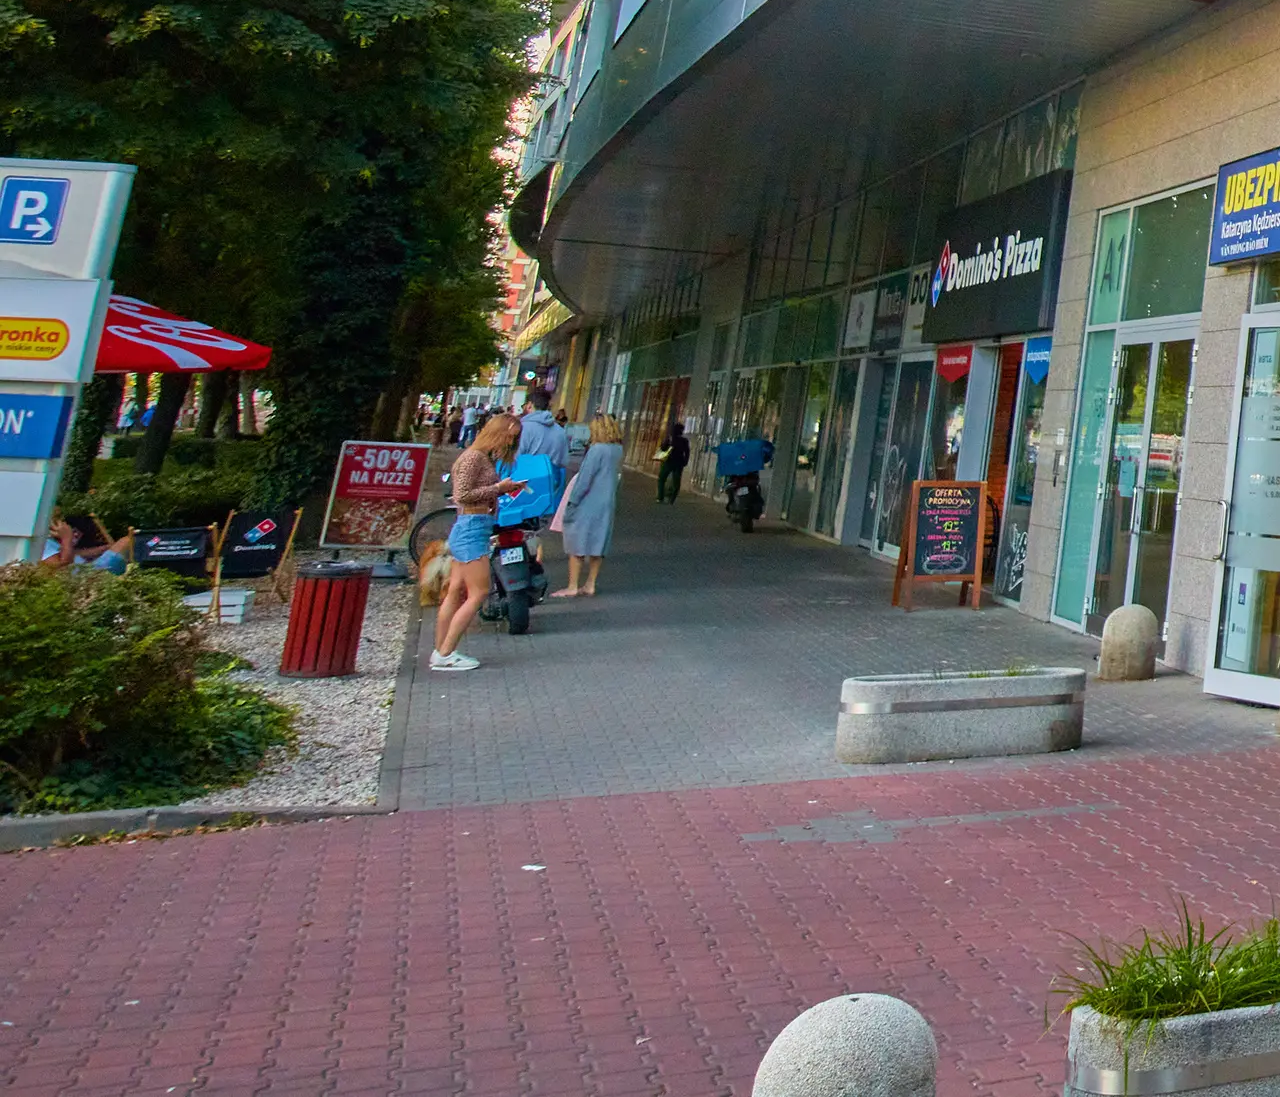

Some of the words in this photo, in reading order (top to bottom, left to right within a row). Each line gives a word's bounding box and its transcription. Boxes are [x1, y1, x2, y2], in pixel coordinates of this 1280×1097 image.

[10, 191, 48, 228] P
[1221, 219, 1252, 239] Katarzyna
[946, 237, 1003, 292] Domino's
[1002, 230, 1044, 278] Pizza
[0, 326, 60, 342] ronka
[354, 449, 415, 470] -50%
[350, 471, 369, 484] NA
[373, 472, 413, 486] PIZZE
